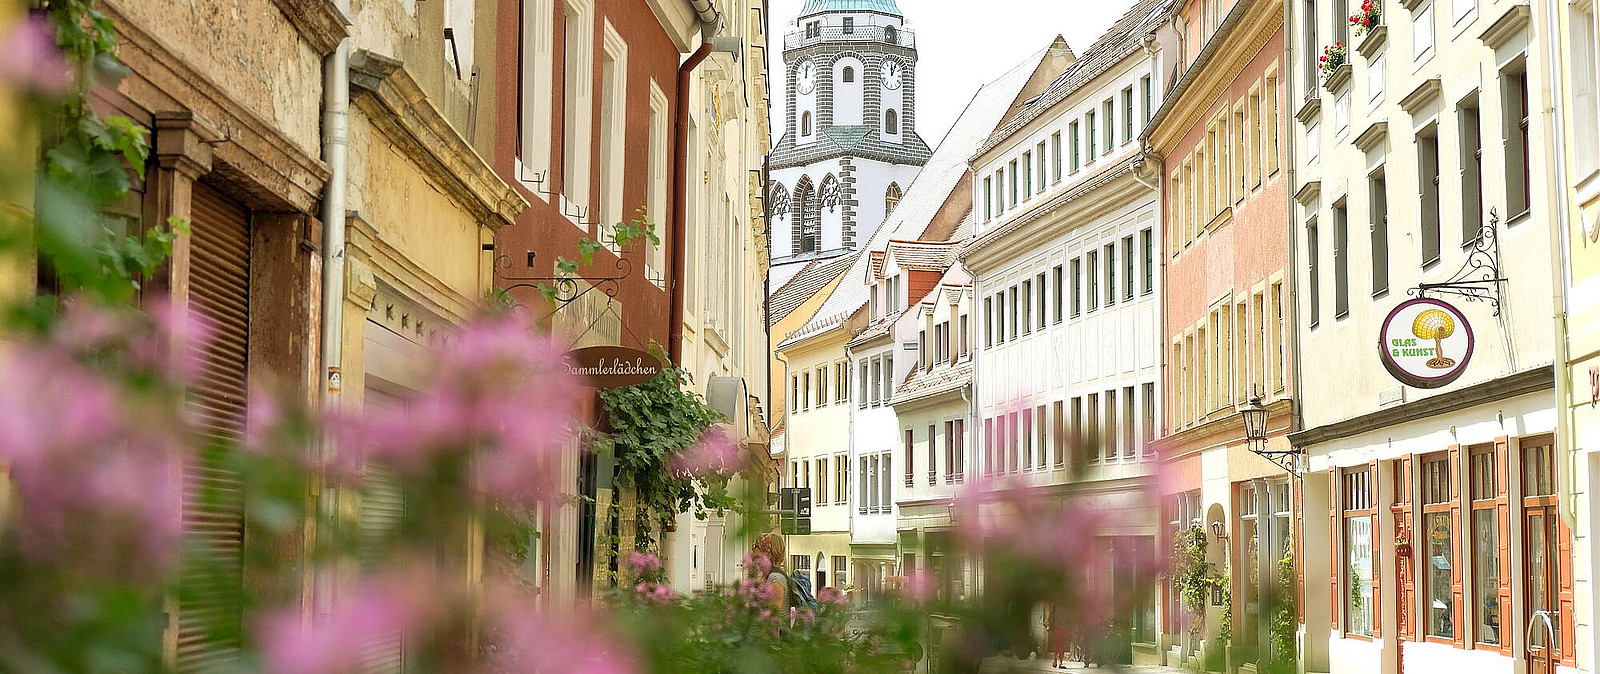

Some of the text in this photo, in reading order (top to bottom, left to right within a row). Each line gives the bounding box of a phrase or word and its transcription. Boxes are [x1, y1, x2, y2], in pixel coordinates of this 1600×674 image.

[1391, 339, 1417, 347] GLAS
[1392, 348, 1434, 357] & KUNST
[561, 355, 657, 375] Sammlerlädchen
